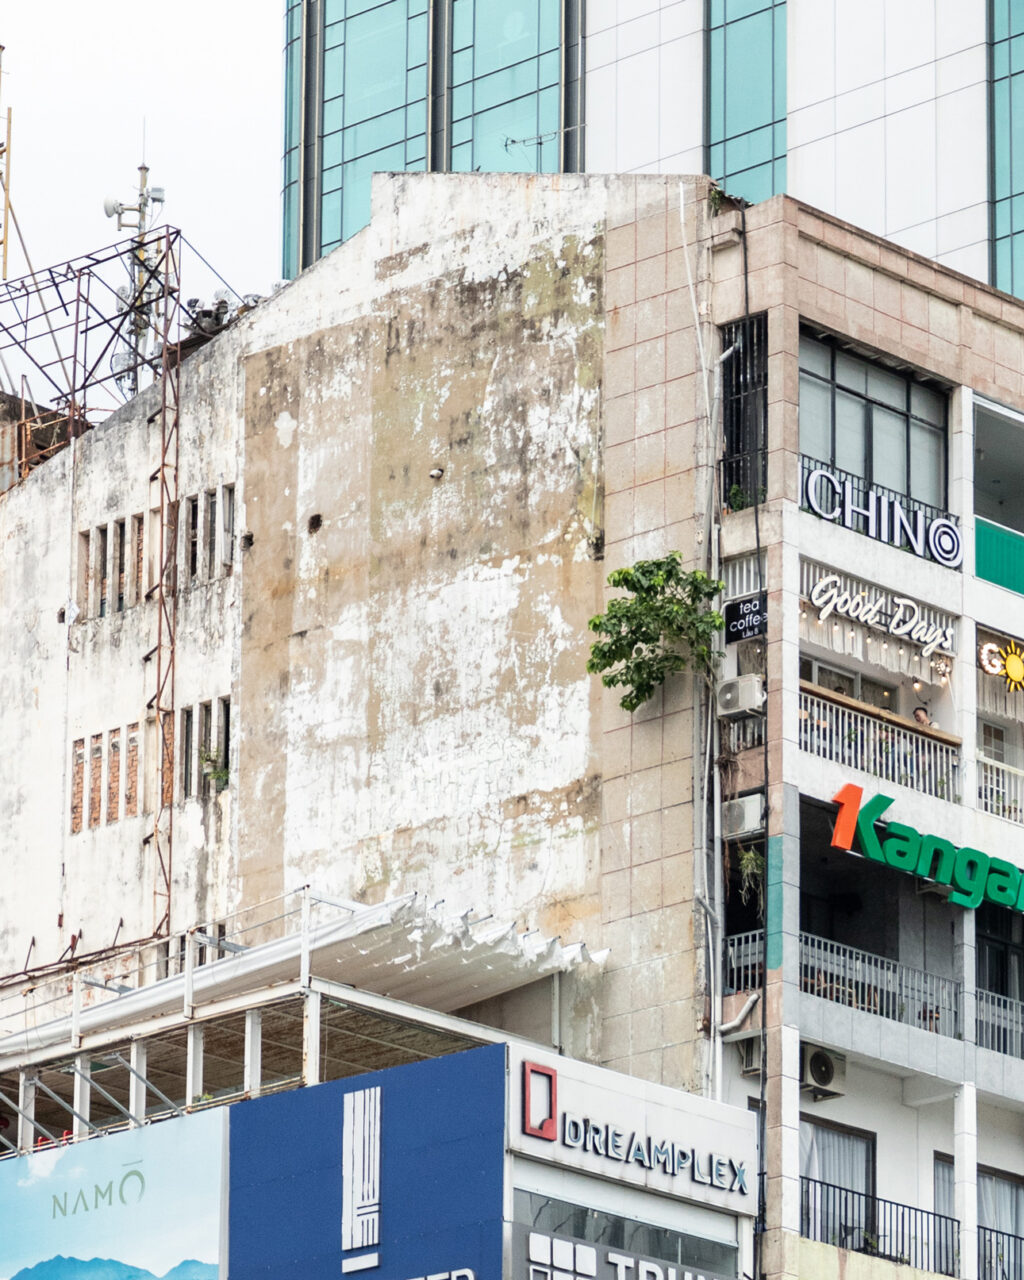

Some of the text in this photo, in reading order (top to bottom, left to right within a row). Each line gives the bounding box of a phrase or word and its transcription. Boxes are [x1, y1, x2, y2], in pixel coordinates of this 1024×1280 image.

[807, 470, 963, 568] CHINO
[740, 601, 759, 614] tea
[812, 575, 953, 657] Good Days
[561, 1112, 749, 1195] DREAMPLEX
